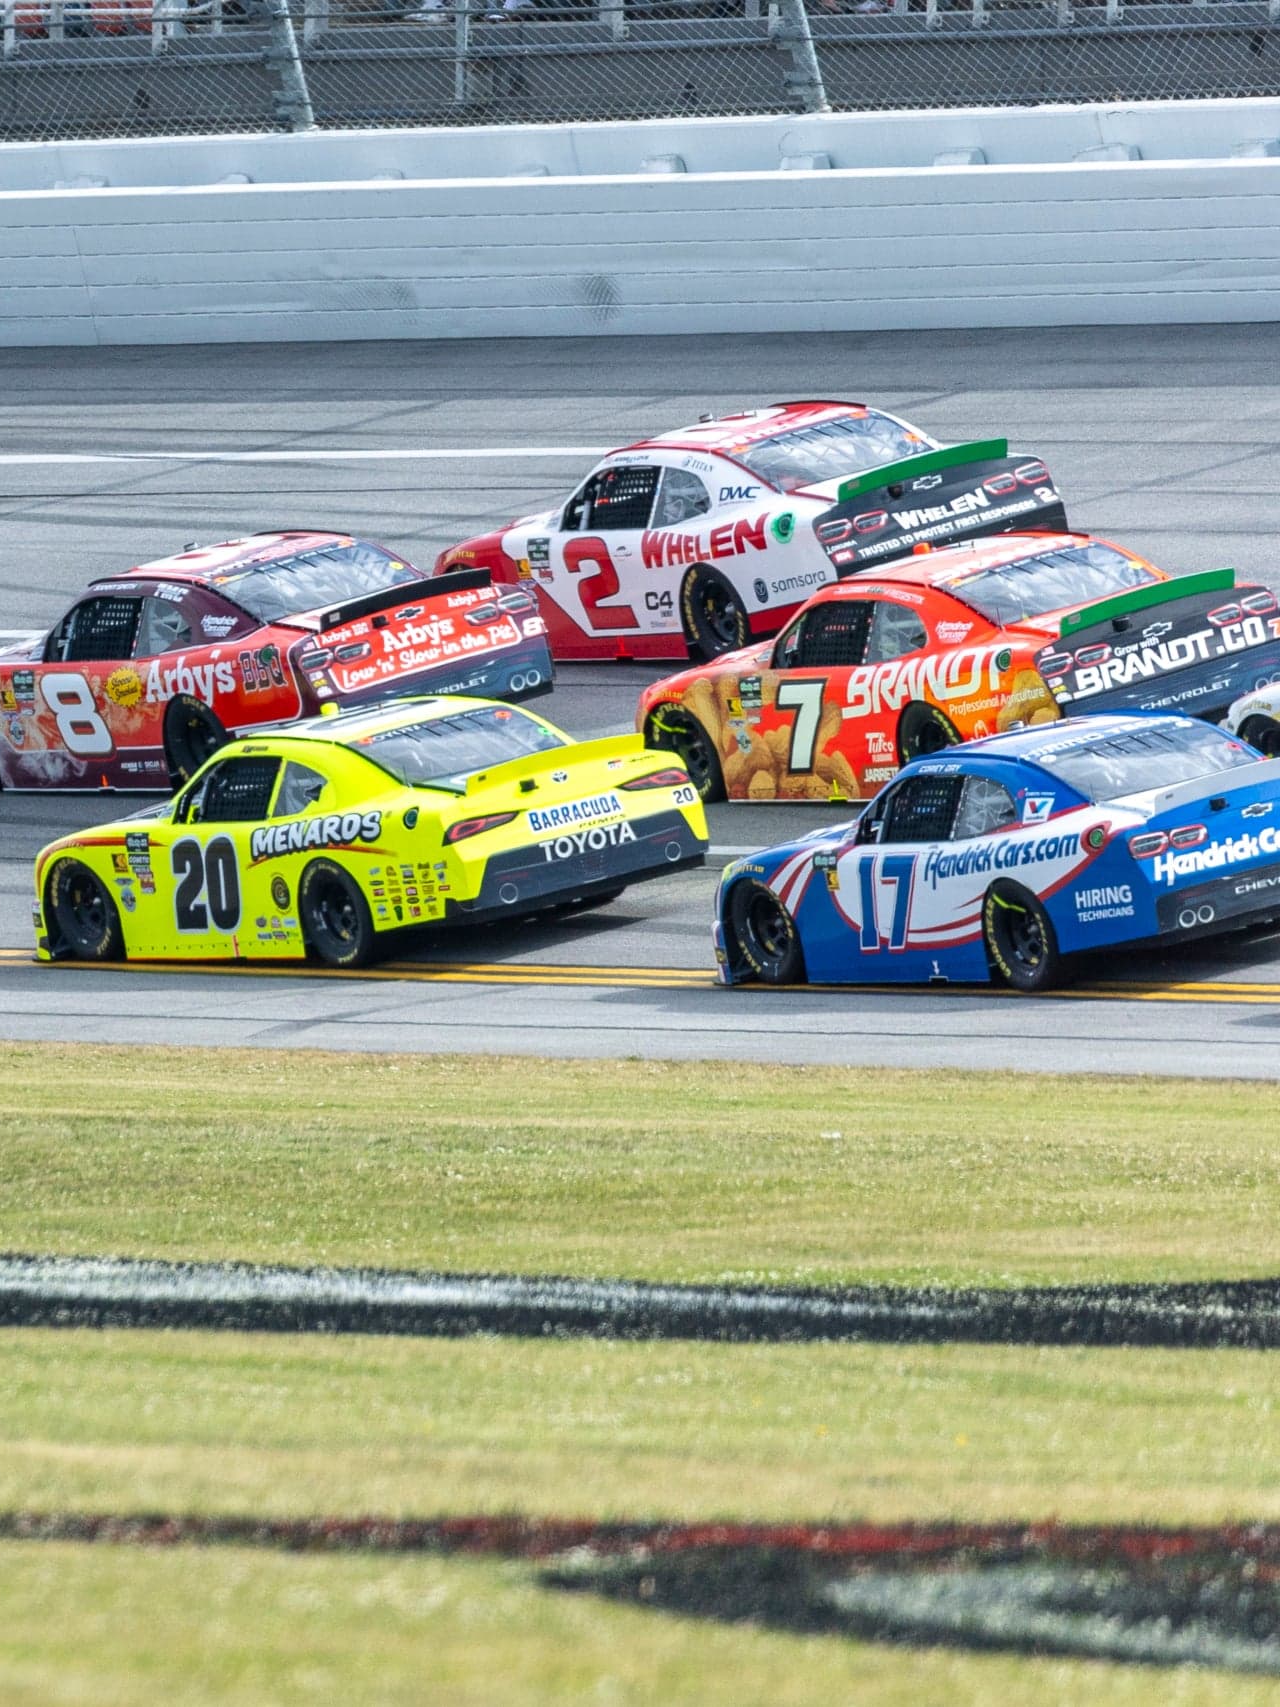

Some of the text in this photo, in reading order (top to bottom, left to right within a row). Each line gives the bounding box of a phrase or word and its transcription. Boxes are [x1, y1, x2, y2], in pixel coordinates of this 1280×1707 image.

[720, 487, 760, 501] DWC
[891, 487, 992, 530] WHELEN
[1033, 486, 1058, 504] 2
[642, 512, 770, 568] WHELEN
[860, 538, 901, 558] TRUSTED
[915, 522, 954, 543] PROTECT
[955, 514, 982, 533] FIRST
[563, 536, 640, 630] 2
[645, 591, 674, 610] C4
[771, 571, 826, 593] samsara
[379, 614, 455, 654] Arby's
[520, 618, 544, 637] 8
[342, 664, 378, 689] Low
[400, 640, 441, 667] Slow
[442, 632, 462, 652] in
[461, 624, 487, 646] the
[487, 617, 516, 639] Pit
[1072, 616, 1266, 699] BRANDT.CO
[1114, 636, 1161, 659] Grow with
[146, 649, 237, 709] Arby's
[842, 643, 1030, 719] BRANDT
[1141, 680, 1232, 711] CHEVROLET
[40, 672, 114, 757] 8
[949, 692, 1000, 716] Professional
[1000, 686, 1046, 708] Agriculture
[777, 679, 827, 774] 7
[865, 732, 896, 755] Tufco
[528, 795, 623, 831] BARRACUDA
[673, 786, 695, 804] 20
[251, 811, 382, 862] MENARDS
[540, 823, 637, 861] TOYOTA
[170, 833, 242, 935] 20
[857, 853, 920, 951] 17
[1075, 885, 1133, 909] HIRING
[1078, 906, 1135, 923] TECHNICIANS
